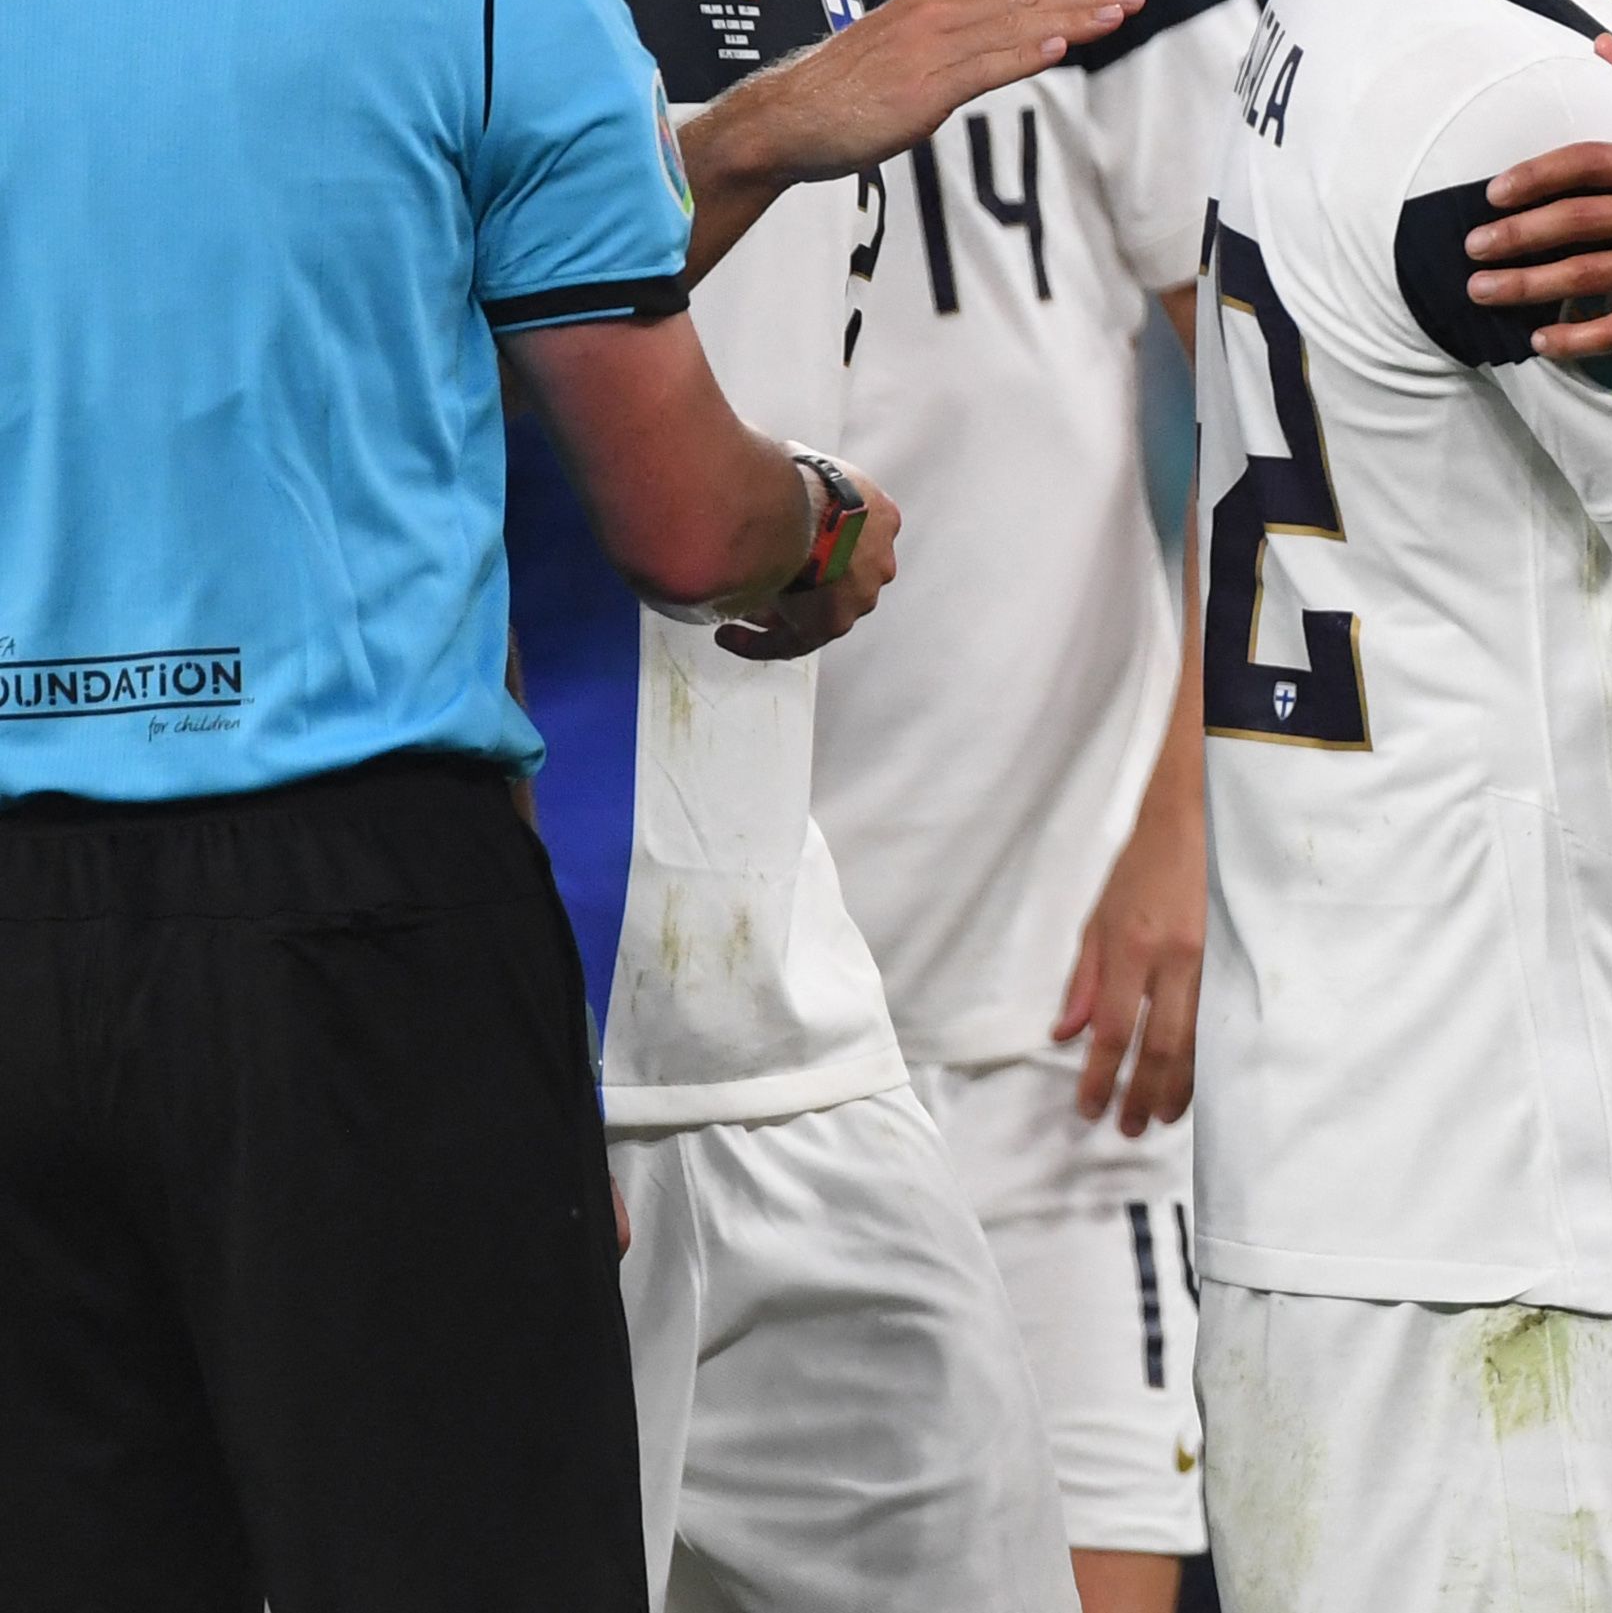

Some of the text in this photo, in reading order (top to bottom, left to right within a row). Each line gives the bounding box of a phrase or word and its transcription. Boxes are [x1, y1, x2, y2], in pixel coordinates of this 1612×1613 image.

[908, 106, 1053, 317] 14
[148, 714, 241, 743] for children
